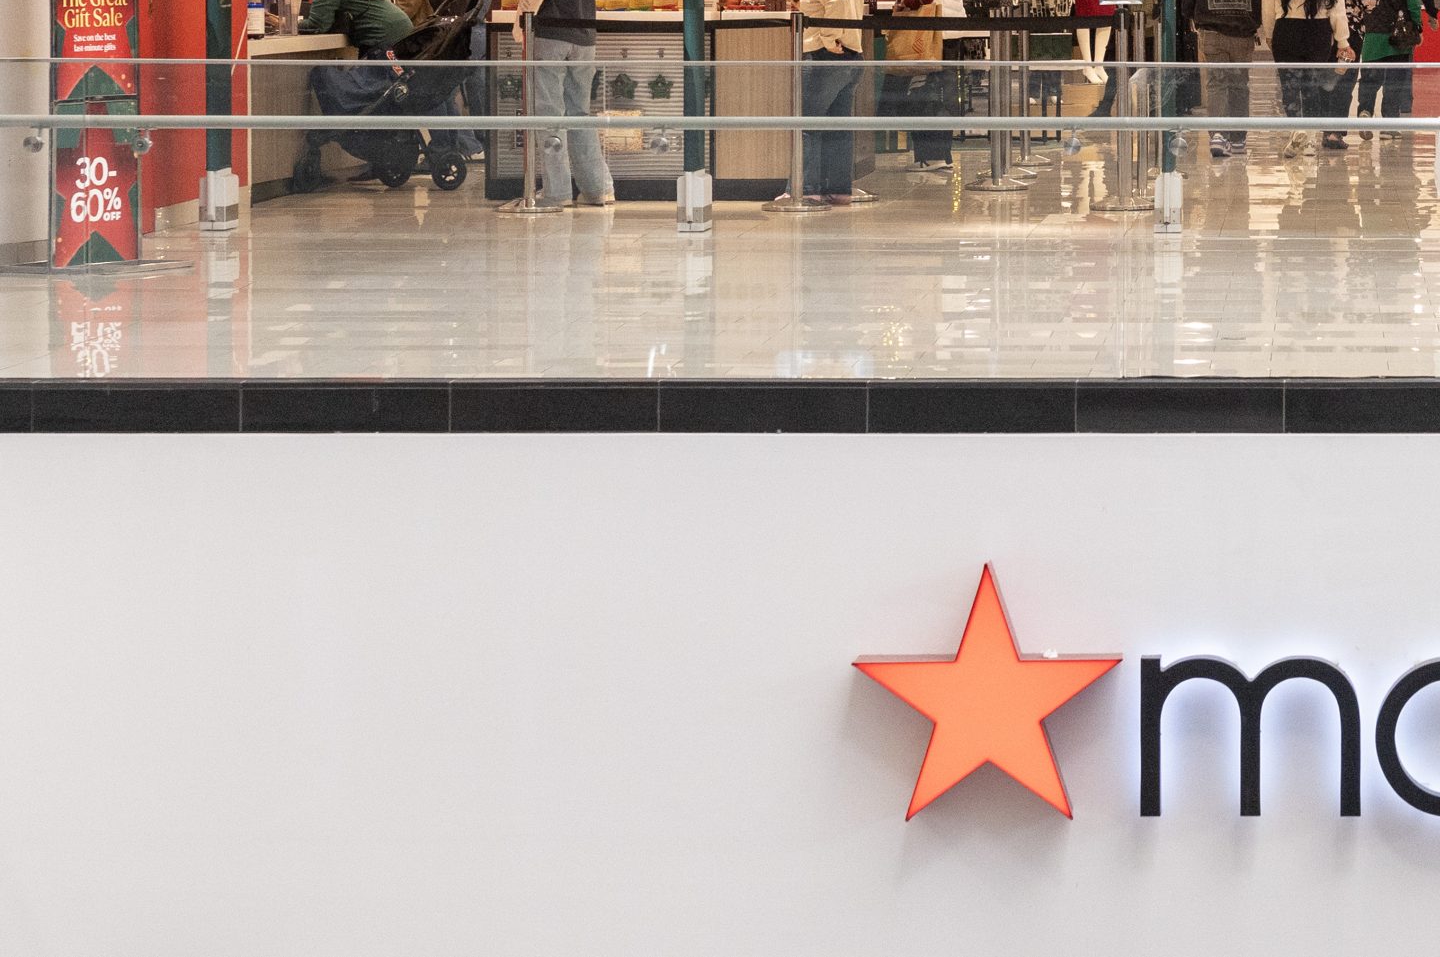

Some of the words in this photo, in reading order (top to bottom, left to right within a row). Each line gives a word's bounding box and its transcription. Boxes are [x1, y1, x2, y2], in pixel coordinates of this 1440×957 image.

[64, 7, 91, 29] Gift
[93, 7, 123, 27] Sale
[73, 34, 86, 42] Save
[104, 32, 116, 41] best
[75, 156, 117, 189] 30-
[70, 186, 122, 222] 60%
[102, 211, 122, 221] OFF
